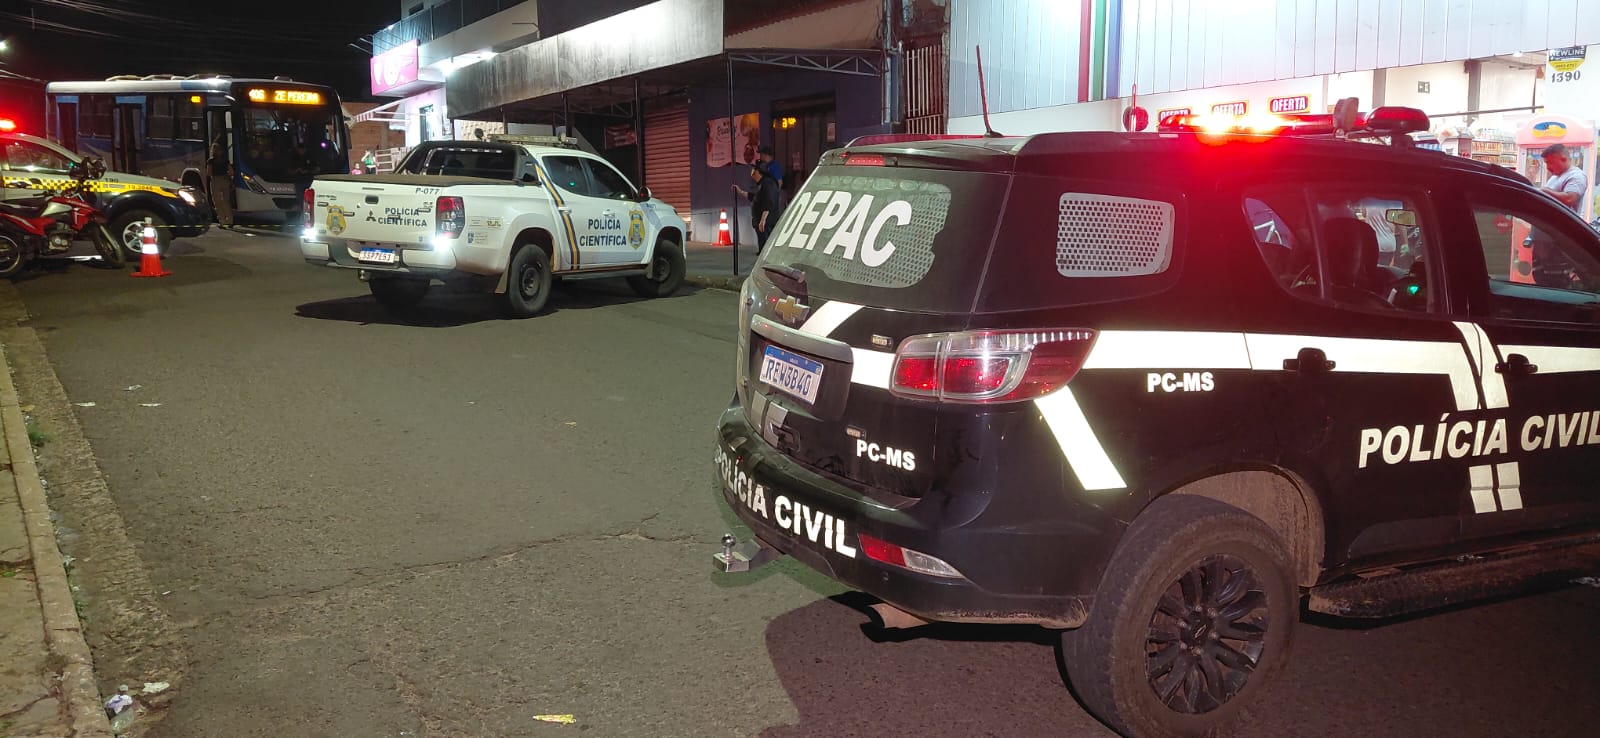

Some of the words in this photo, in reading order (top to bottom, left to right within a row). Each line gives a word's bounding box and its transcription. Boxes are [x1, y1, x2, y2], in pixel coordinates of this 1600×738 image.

[1552, 70, 1581, 83] 1390
[249, 89, 265, 100] 406
[1272, 97, 1306, 112] OFERTA
[415, 187, 440, 195] P-077
[385, 207, 420, 217] POLÍCIA
[378, 217, 428, 228] CIENTÍFICA
[588, 218, 621, 230] POLÍCIA
[775, 190, 912, 267] DEPAC
[580, 233, 627, 247] CIENTÍFICA
[766, 359, 812, 396] REW3B40
[1147, 372, 1215, 393] PC-MS
[1358, 411, 1508, 469] POLÍCIA
[1520, 410, 1600, 452] CIVIL
[856, 440, 916, 471] PC-MS
[715, 445, 769, 519] POLÍCIA
[774, 495, 857, 559] CIVIL
